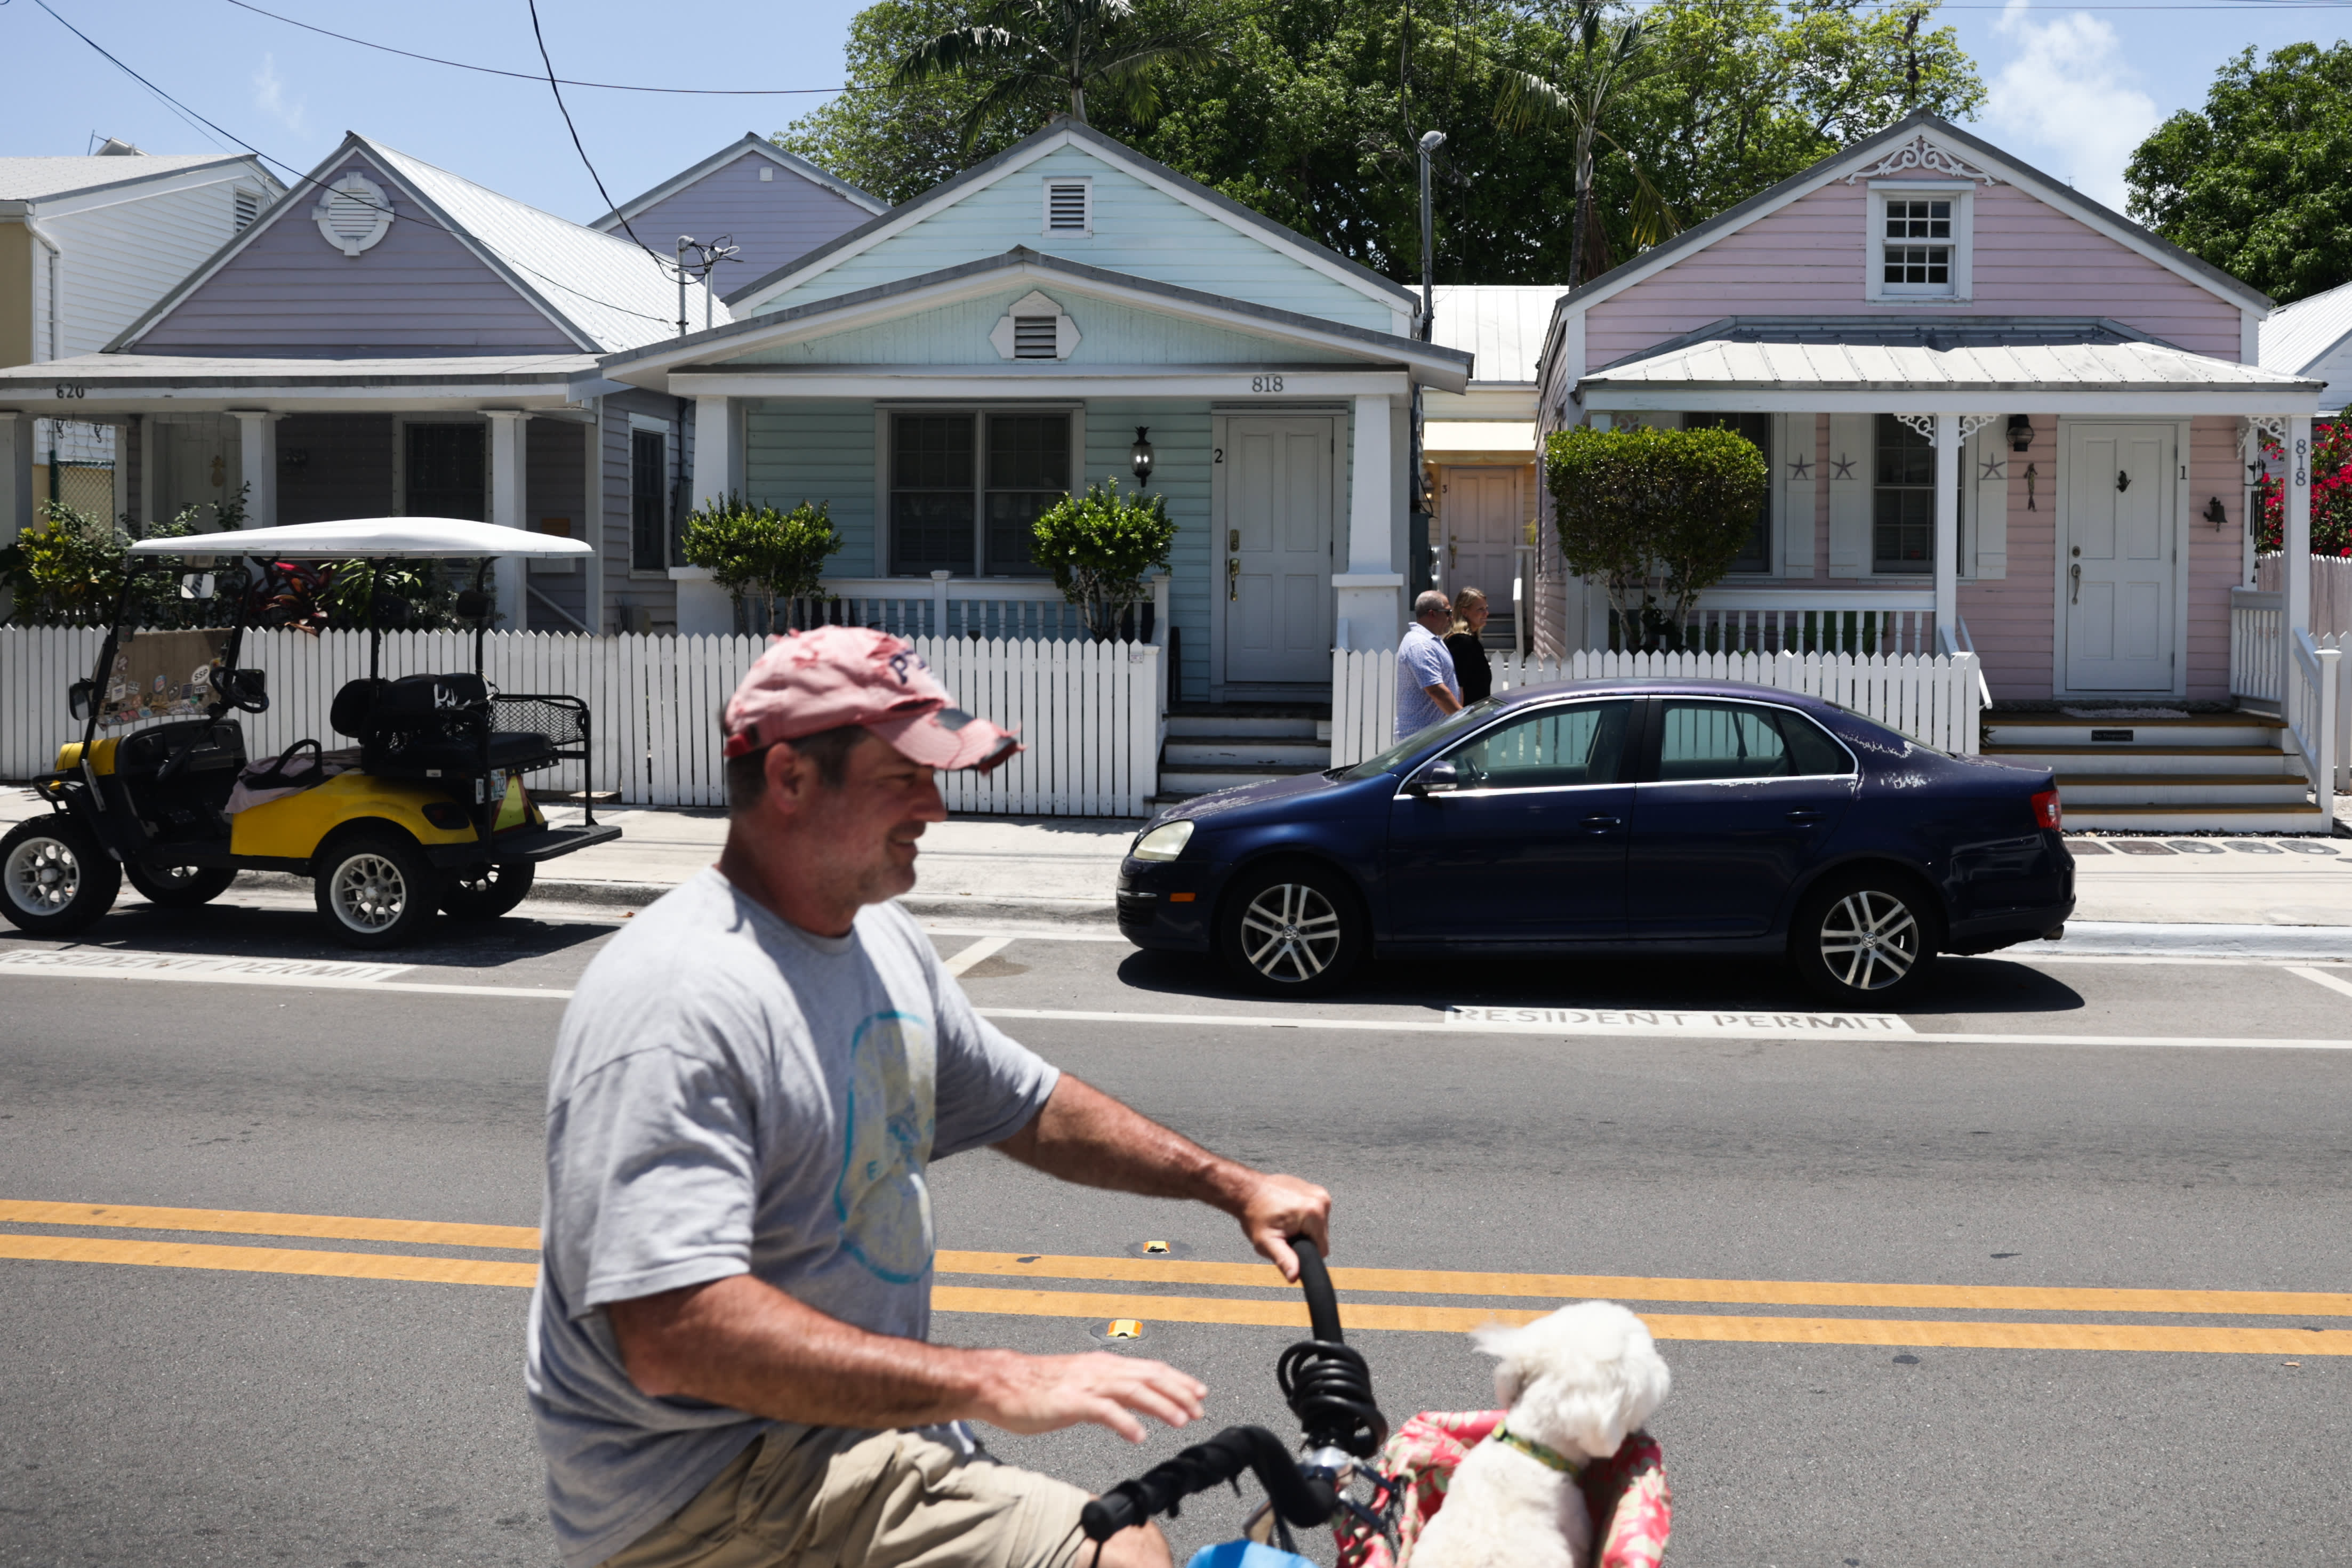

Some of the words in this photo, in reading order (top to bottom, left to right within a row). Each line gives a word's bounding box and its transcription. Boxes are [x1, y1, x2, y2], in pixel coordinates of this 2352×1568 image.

[56, 383, 84, 398] 820
[1253, 376, 1283, 392] 818
[1215, 448, 1223, 463] 2
[2295, 439, 2306, 486] 818
[2180, 465, 2187, 480] 1
[1442, 485, 1447, 494] 3
[213, 961, 401, 978] PERMIT
[1454, 1009, 1693, 1026] RESIDENT
[1712, 1014, 1892, 1029] PERMIT
